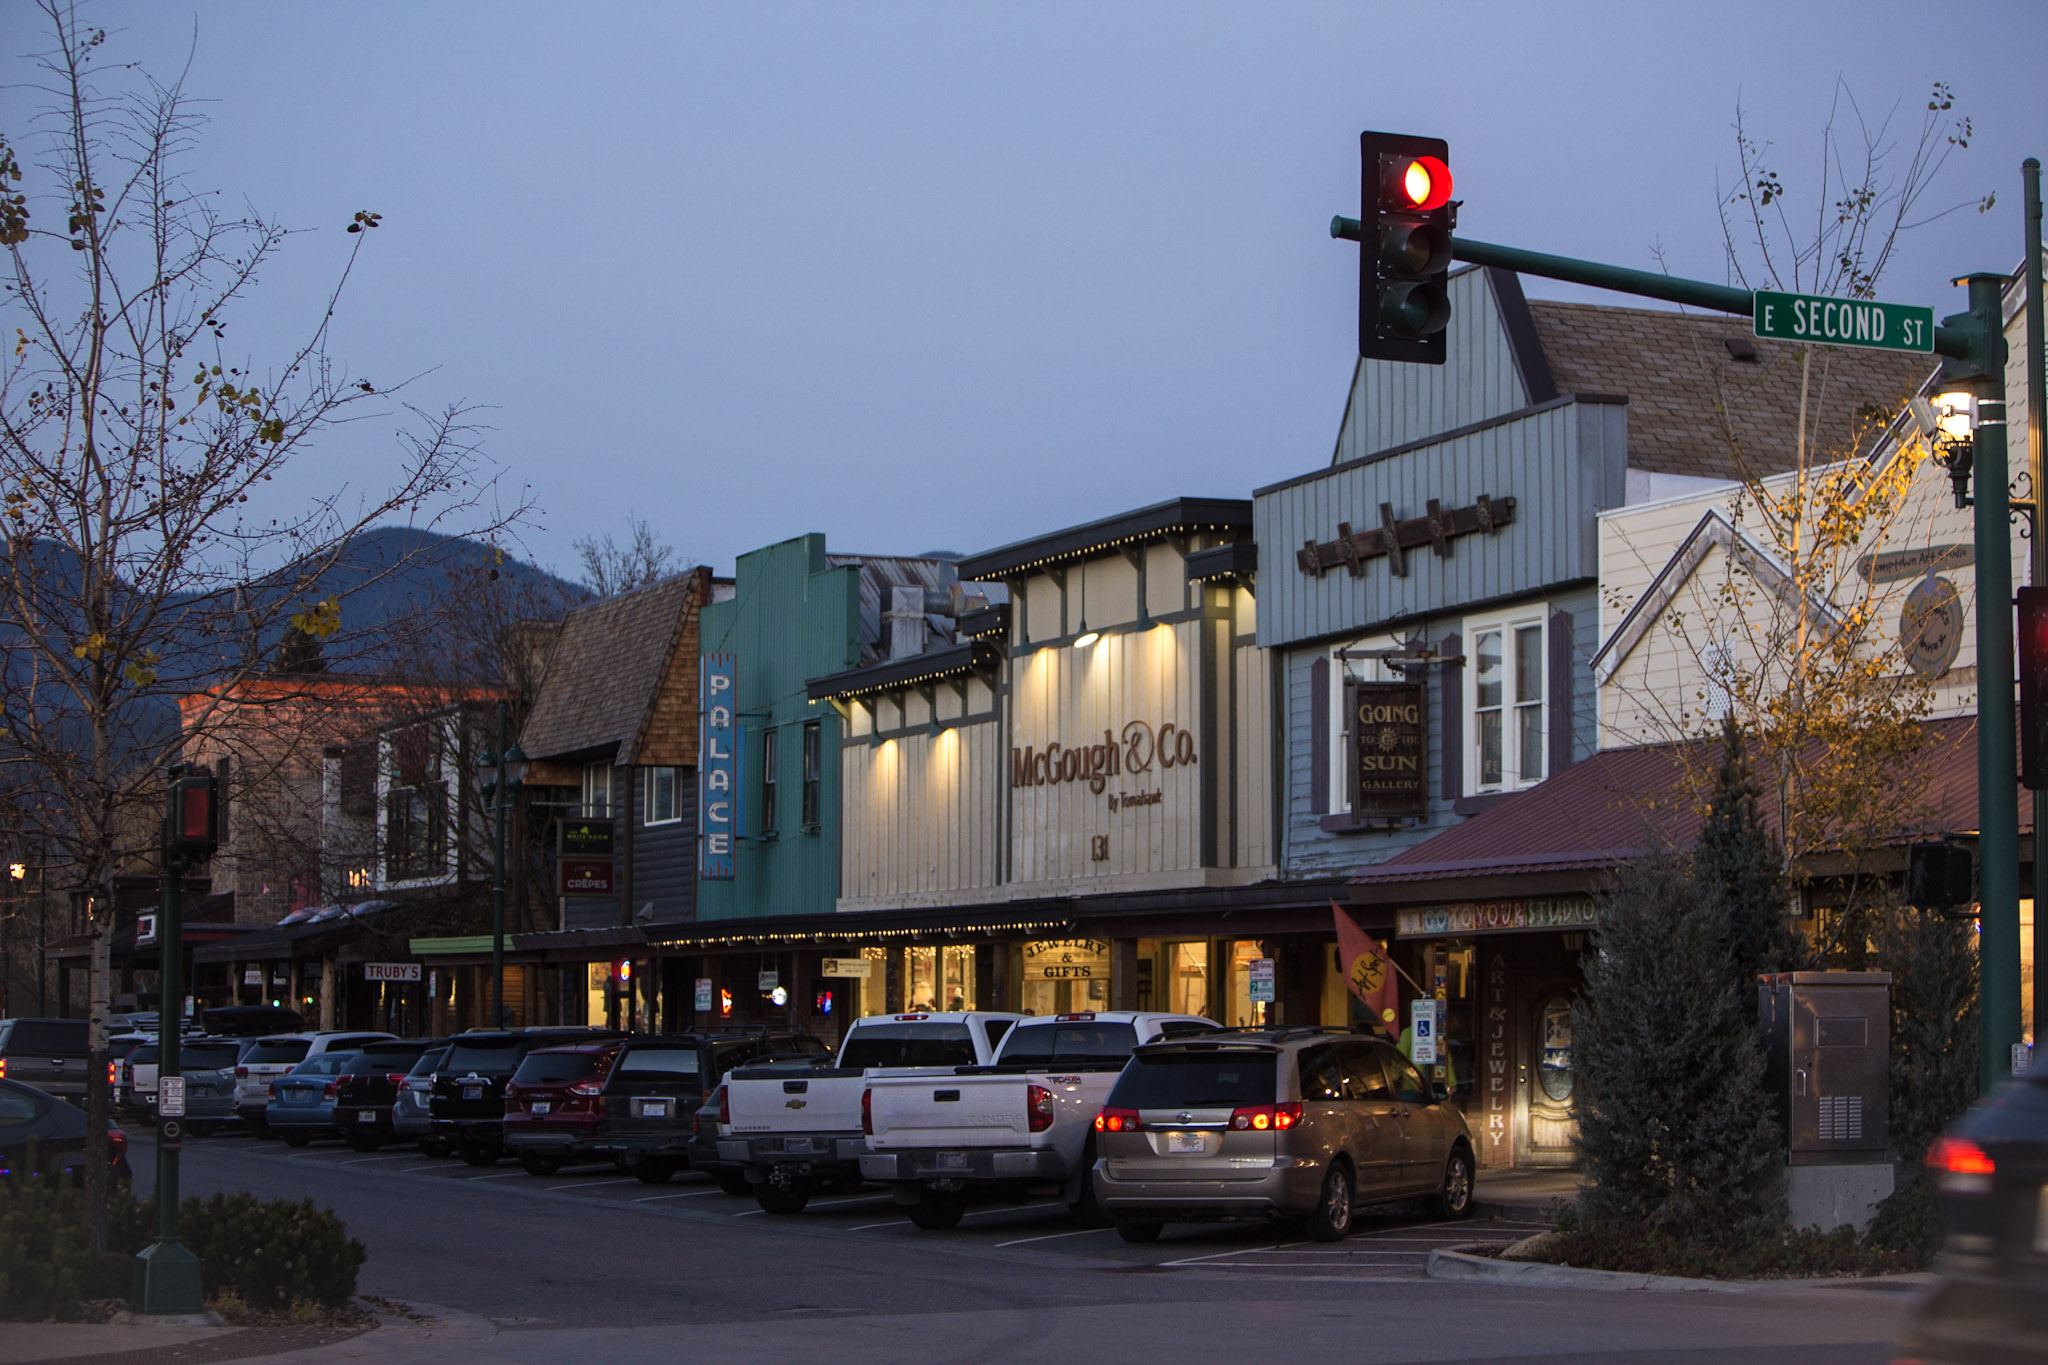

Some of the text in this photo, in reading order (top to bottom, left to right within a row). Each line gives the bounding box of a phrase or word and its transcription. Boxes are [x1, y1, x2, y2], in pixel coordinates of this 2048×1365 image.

[1764, 299, 1924, 346] E SECOND ST
[1919, 551, 1936, 564] Art
[1359, 703, 1420, 724] GOING
[1360, 735, 1420, 745] TO THE
[708, 674, 731, 856] PALACE
[1011, 720, 1197, 794] McGough & Co.
[1362, 755, 1418, 772] SUN
[1362, 779, 1420, 789] GALLERY
[1108, 788, 1162, 813] By Tomahawk
[1091, 835, 1109, 861] 131
[1475, 903, 1522, 926] YOUR
[1528, 898, 1595, 924] STUDIO
[1026, 938, 1107, 957] JEWELRY
[1062, 952, 1073, 963] &
[368, 965, 419, 979] TRUBY'S
[1044, 966, 1091, 978] GIFTS
[1251, 982, 1258, 993] 2
[1488, 953, 1507, 1147] ART & JEWELRY
